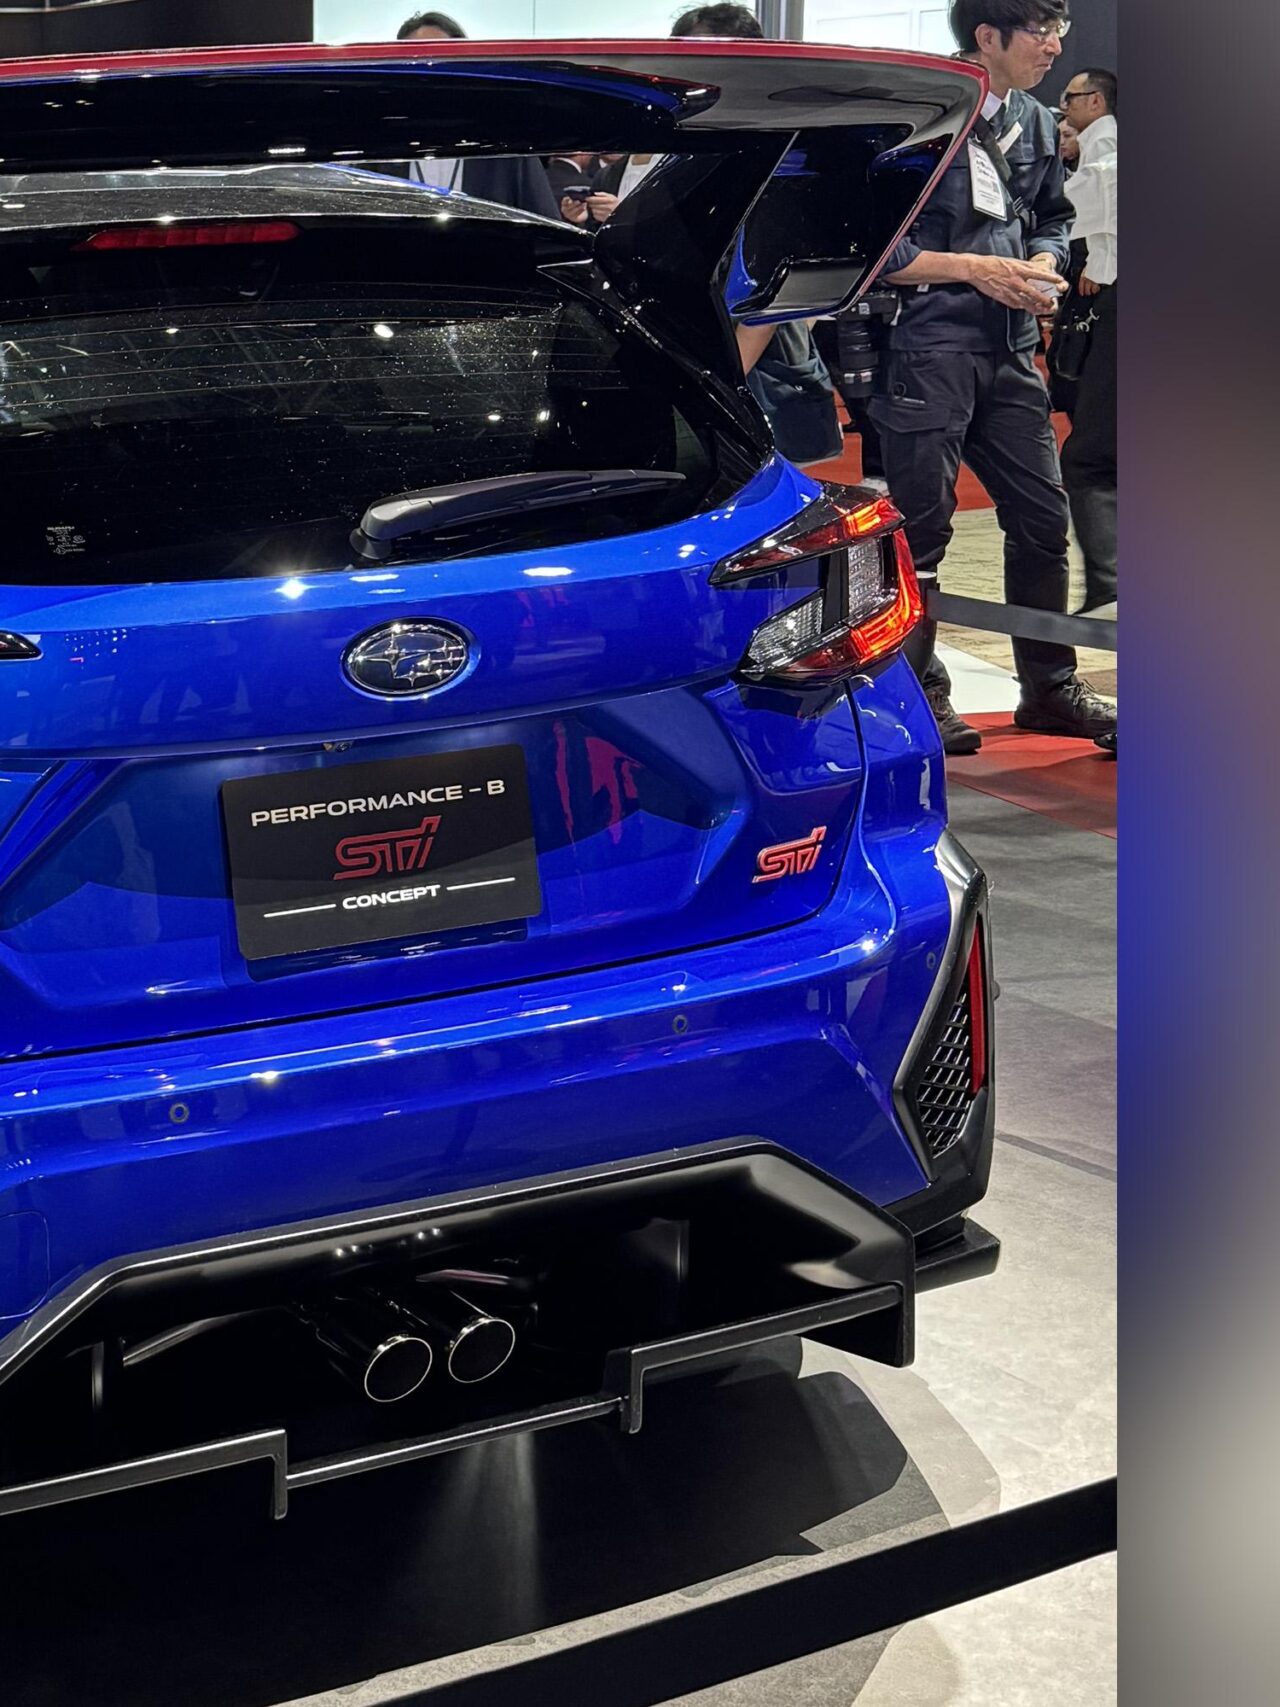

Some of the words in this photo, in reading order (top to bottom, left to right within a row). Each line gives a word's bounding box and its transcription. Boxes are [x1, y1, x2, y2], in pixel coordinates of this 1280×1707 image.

[252, 785, 464, 826] PERFORMANCE
[486, 779, 506, 796] B
[342, 884, 441, 909] CONCEPT
